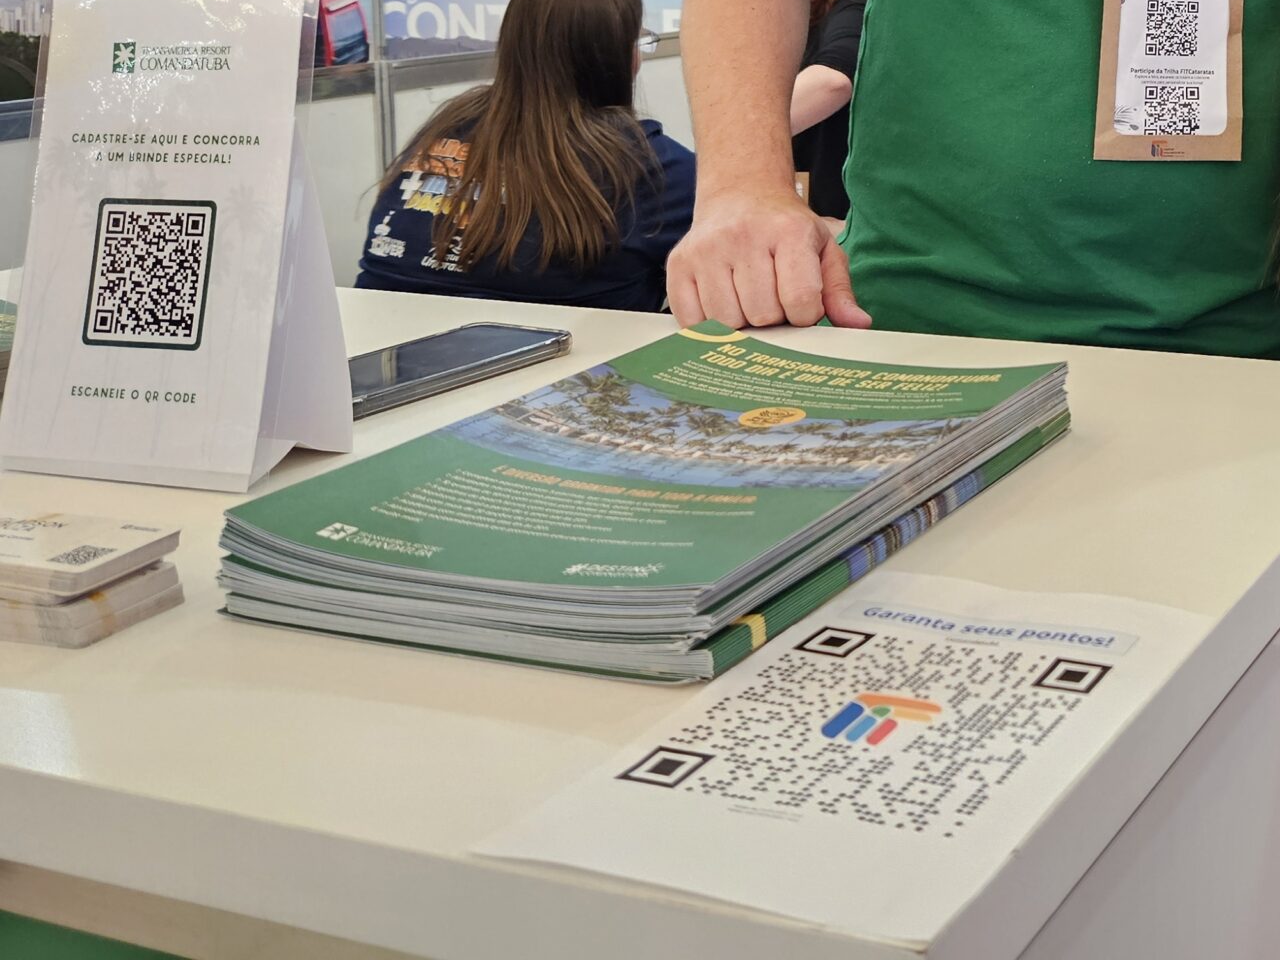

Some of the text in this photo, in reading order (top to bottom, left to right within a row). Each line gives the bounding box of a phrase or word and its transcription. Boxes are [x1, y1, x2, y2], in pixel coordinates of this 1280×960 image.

[200, 46, 232, 56] RESORT
[140, 56, 232, 71] COMANDATUBA
[1130, 67, 1155, 75] Participe
[72, 133, 261, 147] CADASTRE-SE AQUI E CONCORRA
[108, 152, 124, 162] UM
[129, 153, 168, 163] BRINDE
[173, 153, 232, 164] ESPECIAL!
[717, 344, 747, 356] NO
[745, 352, 872, 378] TRANSAMERICA
[700, 351, 748, 369] TODO
[744, 364, 780, 377] DIA
[793, 373, 829, 384] DIA
[827, 377, 855, 387] DE
[854, 380, 893, 389] SER
[892, 382, 949, 391] FELIZ!
[71, 386, 197, 404] ESCANEIE O QR CODE
[863, 606, 1116, 649] Garanta seus pontos!
